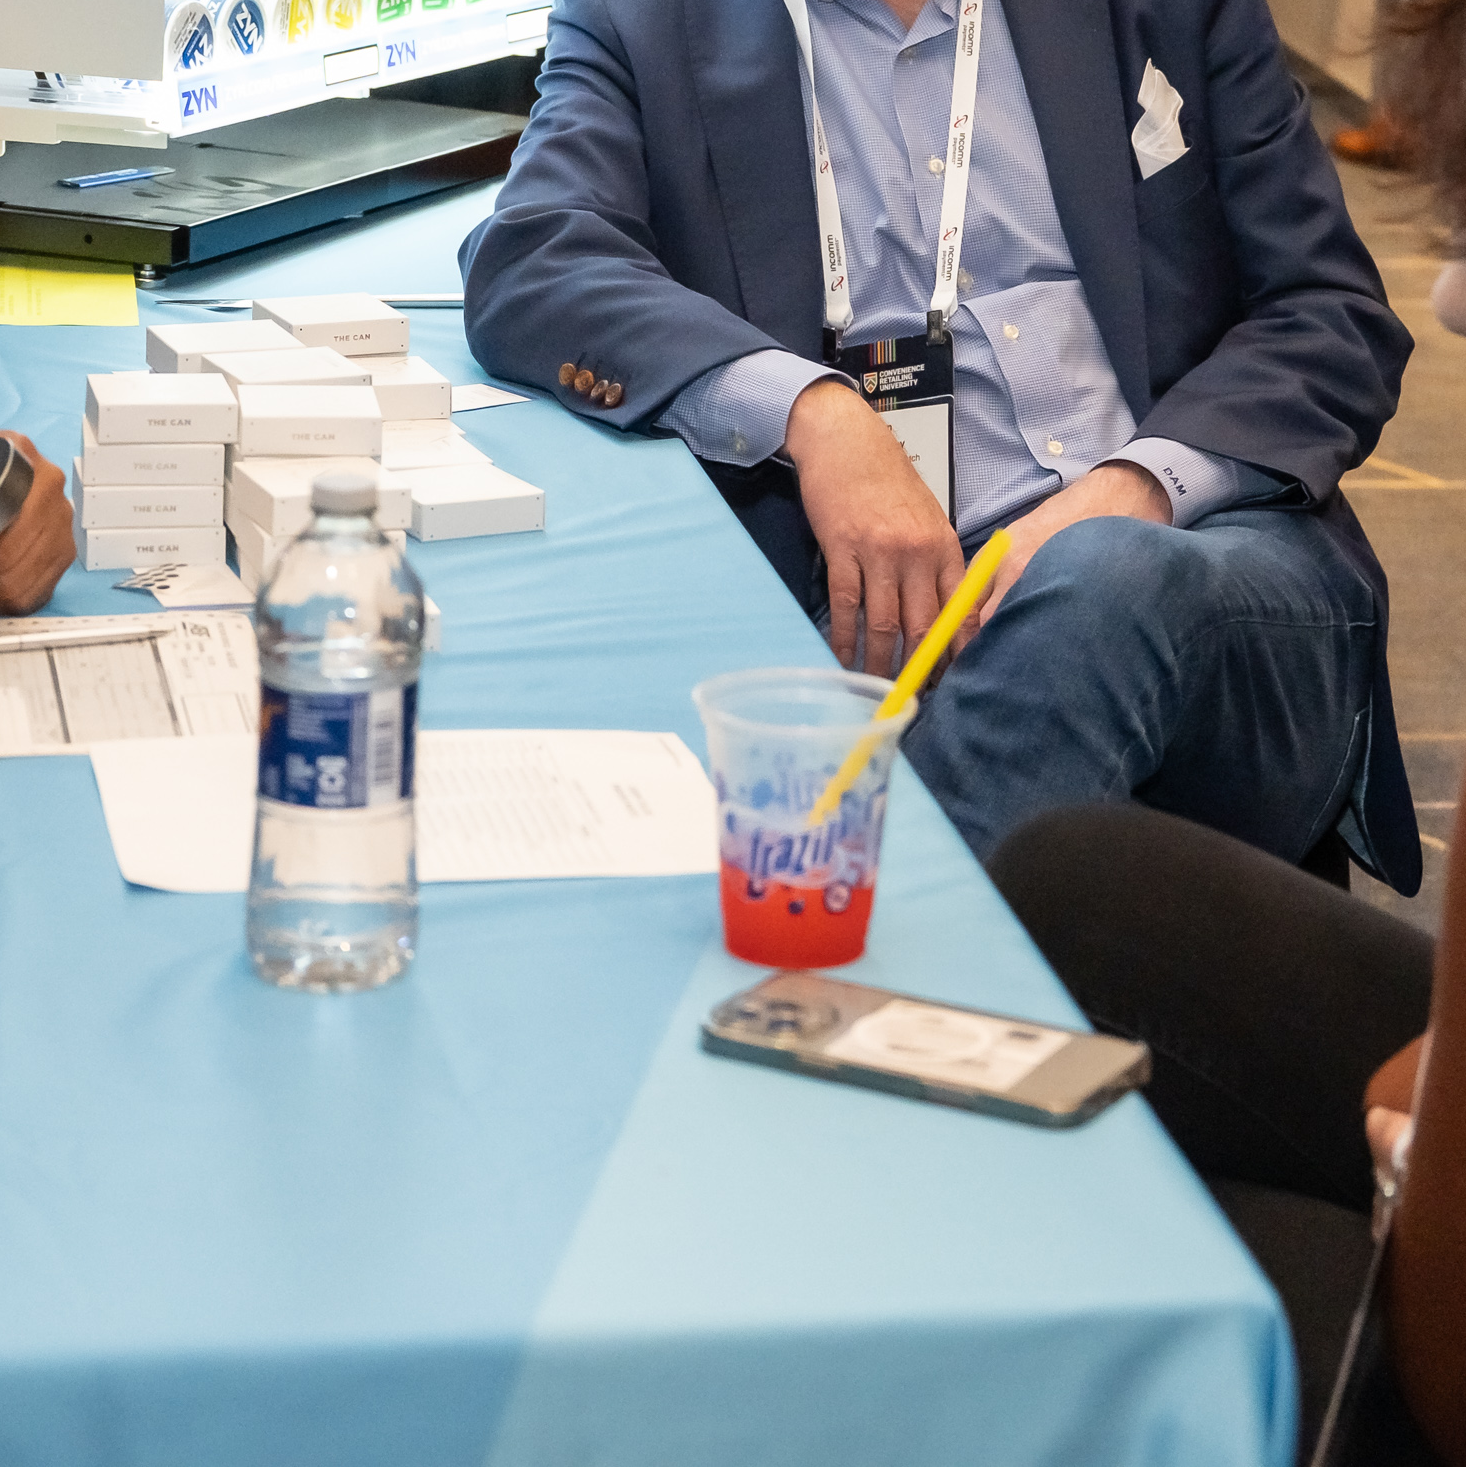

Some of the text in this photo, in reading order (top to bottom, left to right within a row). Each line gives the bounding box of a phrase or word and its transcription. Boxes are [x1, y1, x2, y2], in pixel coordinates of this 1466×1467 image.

[386, 40, 416, 67] ZYN
[182, 85, 217, 117] ZYN
[334, 333, 371, 343] THE CAN
[880, 364, 925, 378] CONVENIENCE
[880, 373, 913, 384] RETAILING
[880, 379, 918, 392] UNIVERSITY
[148, 418, 192, 426] THE CAN
[156, 462, 177, 470] CAN
[1163, 467, 1187, 496] DAM
[133, 505, 152, 513] THE
[136, 545, 155, 553] THE
